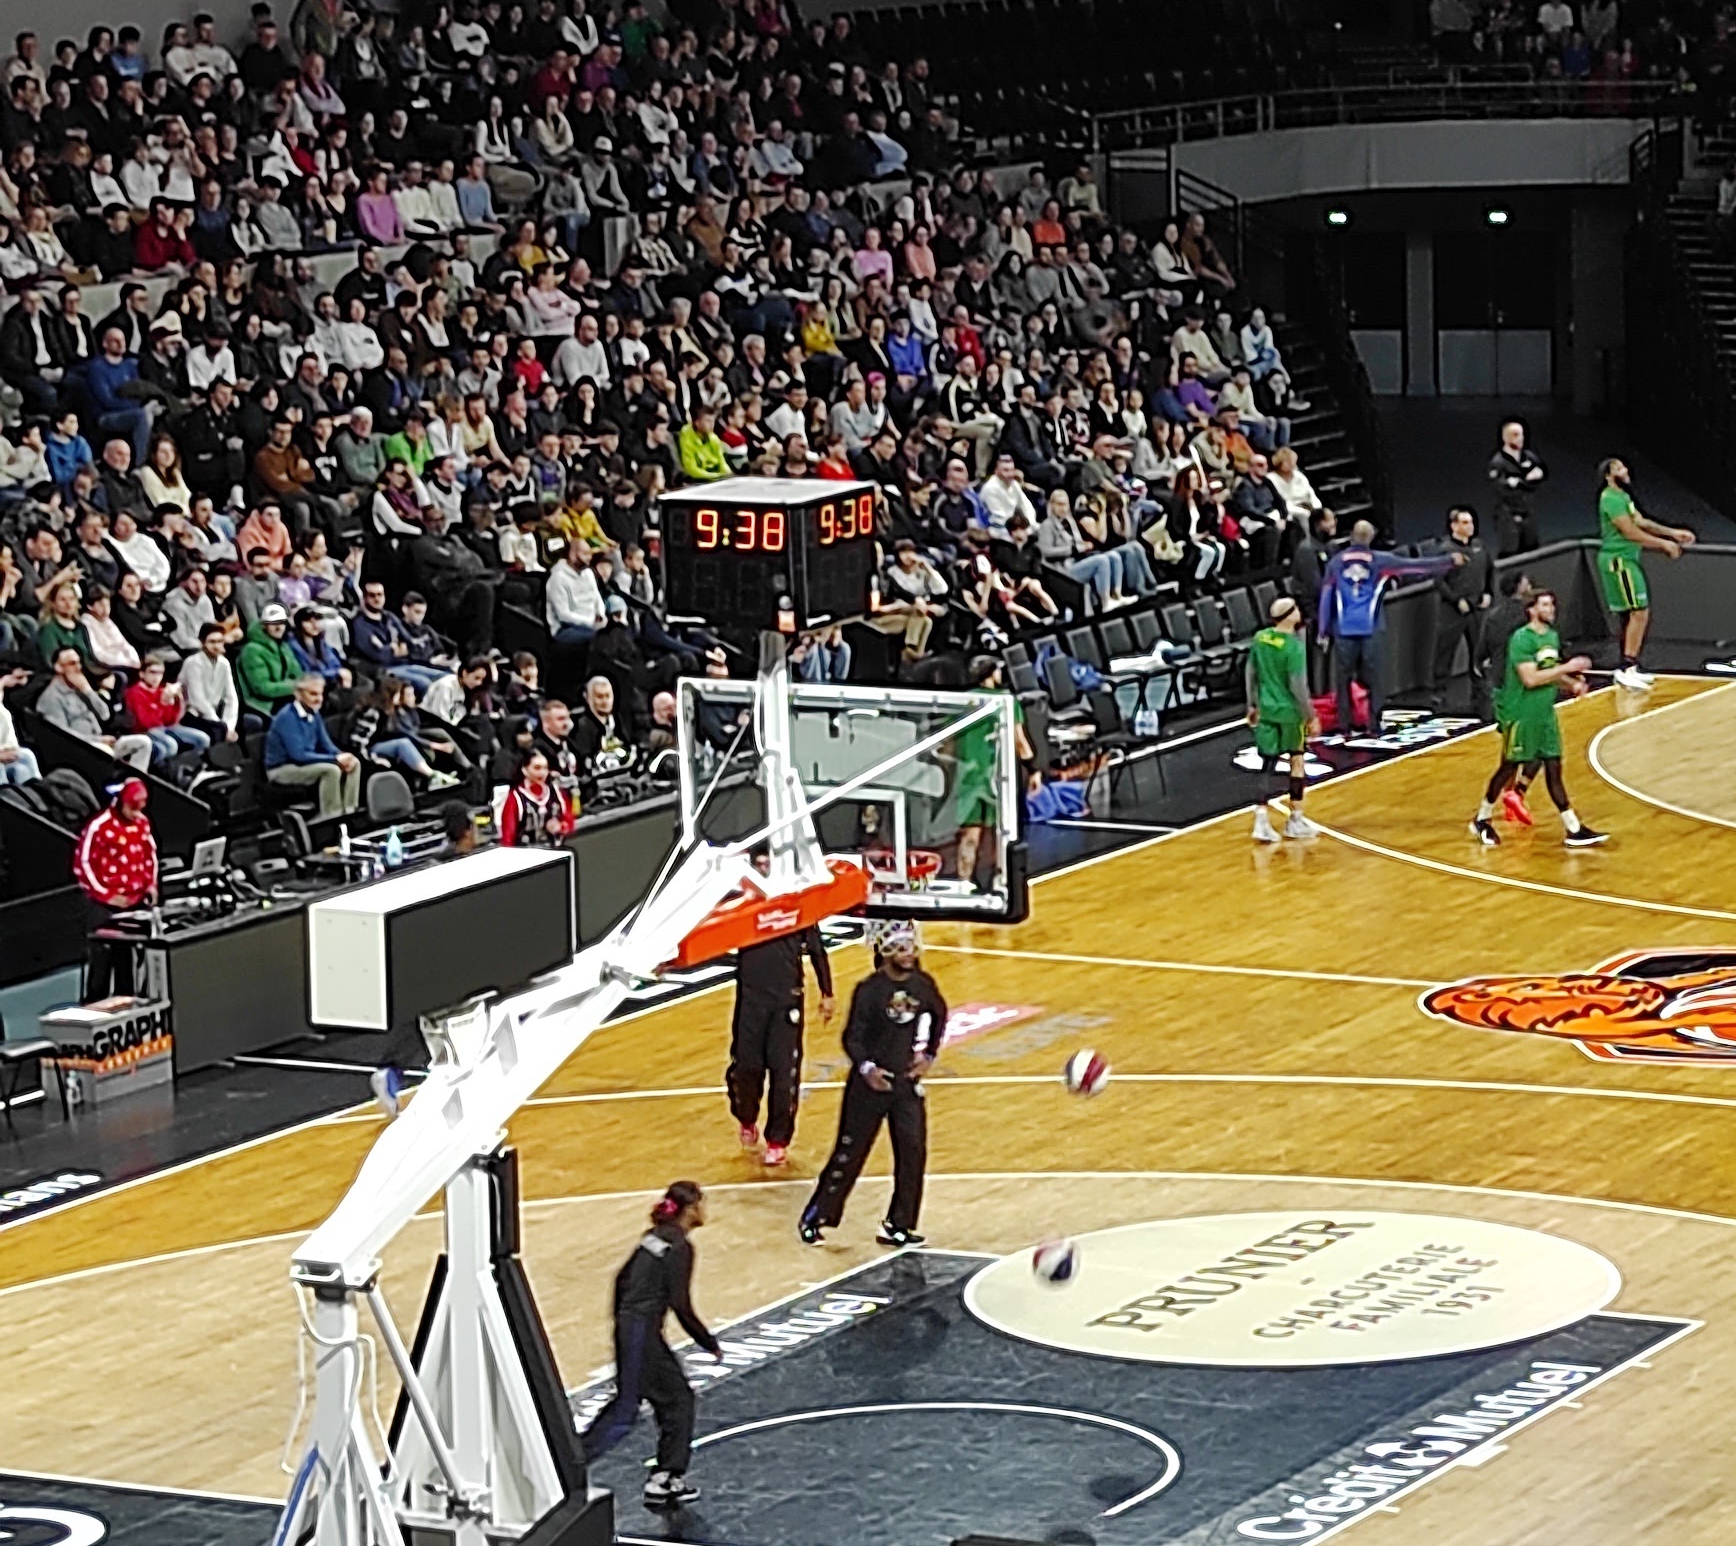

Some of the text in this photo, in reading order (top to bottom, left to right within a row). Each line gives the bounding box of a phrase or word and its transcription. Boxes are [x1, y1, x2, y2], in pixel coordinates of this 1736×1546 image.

[696, 509, 785, 551] 9:38
[820, 494, 873, 545] 9:38
[1085, 1219, 1376, 1333] PRUNIER
[1252, 1243, 1465, 1339] CHARCUTERIE
[1329, 1256, 1500, 1332] FAMILIALE
[1421, 1285, 1506, 1317] 1931
[714, 1291, 893, 1366] Mutuel
[1235, 1360, 1603, 1541] Crédit Mutuel
